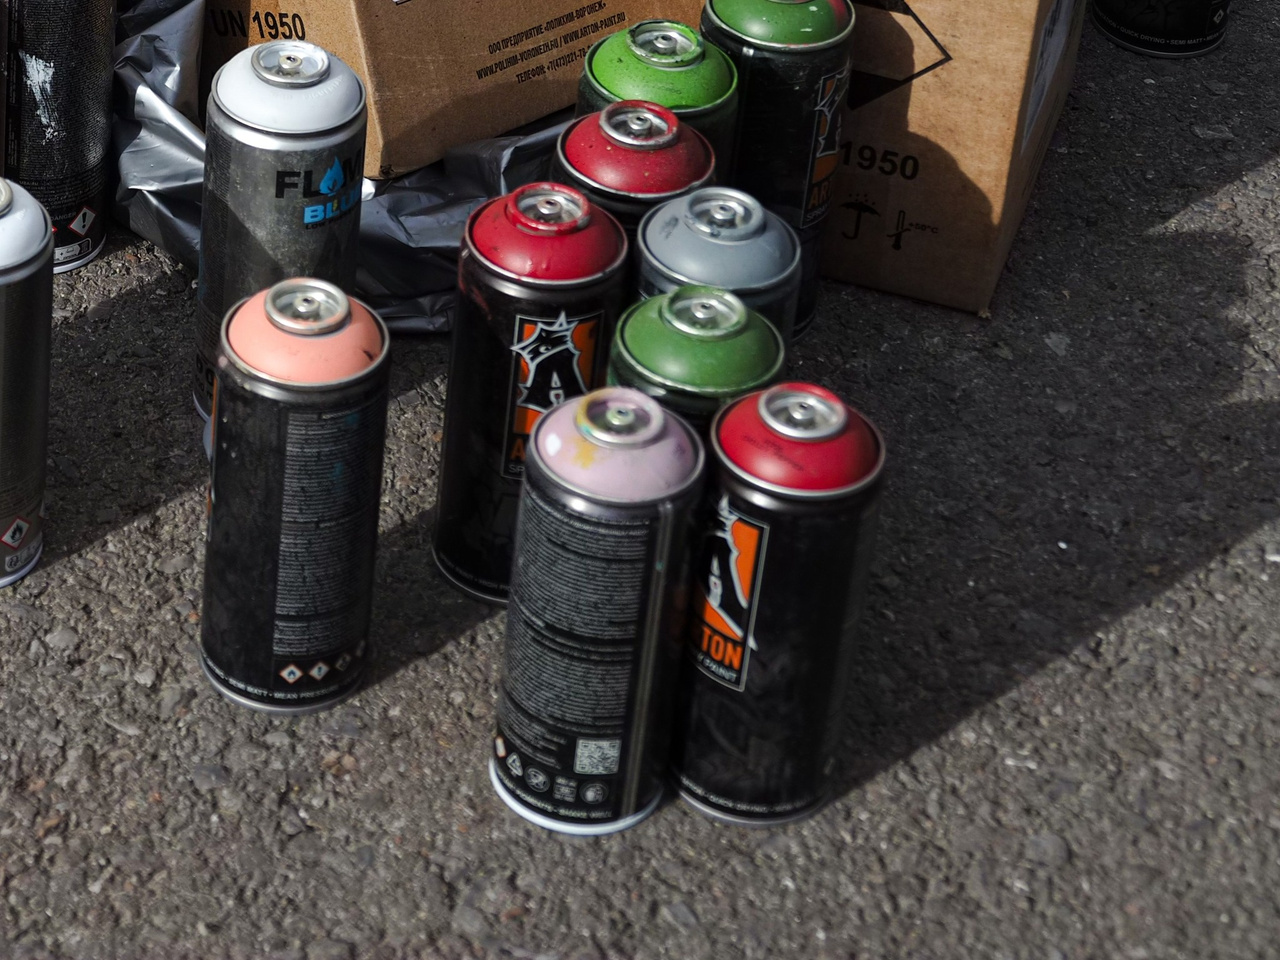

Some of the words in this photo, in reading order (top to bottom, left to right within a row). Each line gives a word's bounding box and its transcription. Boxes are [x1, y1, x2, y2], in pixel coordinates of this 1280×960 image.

[210, 9, 247, 38] UN
[252, 11, 306, 41] 1950
[1120, 26, 1140, 38] QUICK
[1141, 35, 1166, 44] DRYING
[476, 38, 559, 80] WWW.POLIHIM-VORONEZH.RU
[563, 12, 626, 45] WWW.ARTON-PAINT.RU
[488, 43, 502, 55] ООО
[502, 24, 544, 51] ПРЕДПРИЯТИЕ
[516, 64, 547, 84] ТЕЛЕФОН:
[840, 140, 920, 181] 1950
[50, 212, 77, 220] DANGER
[274, 691, 297, 699] MEAN
